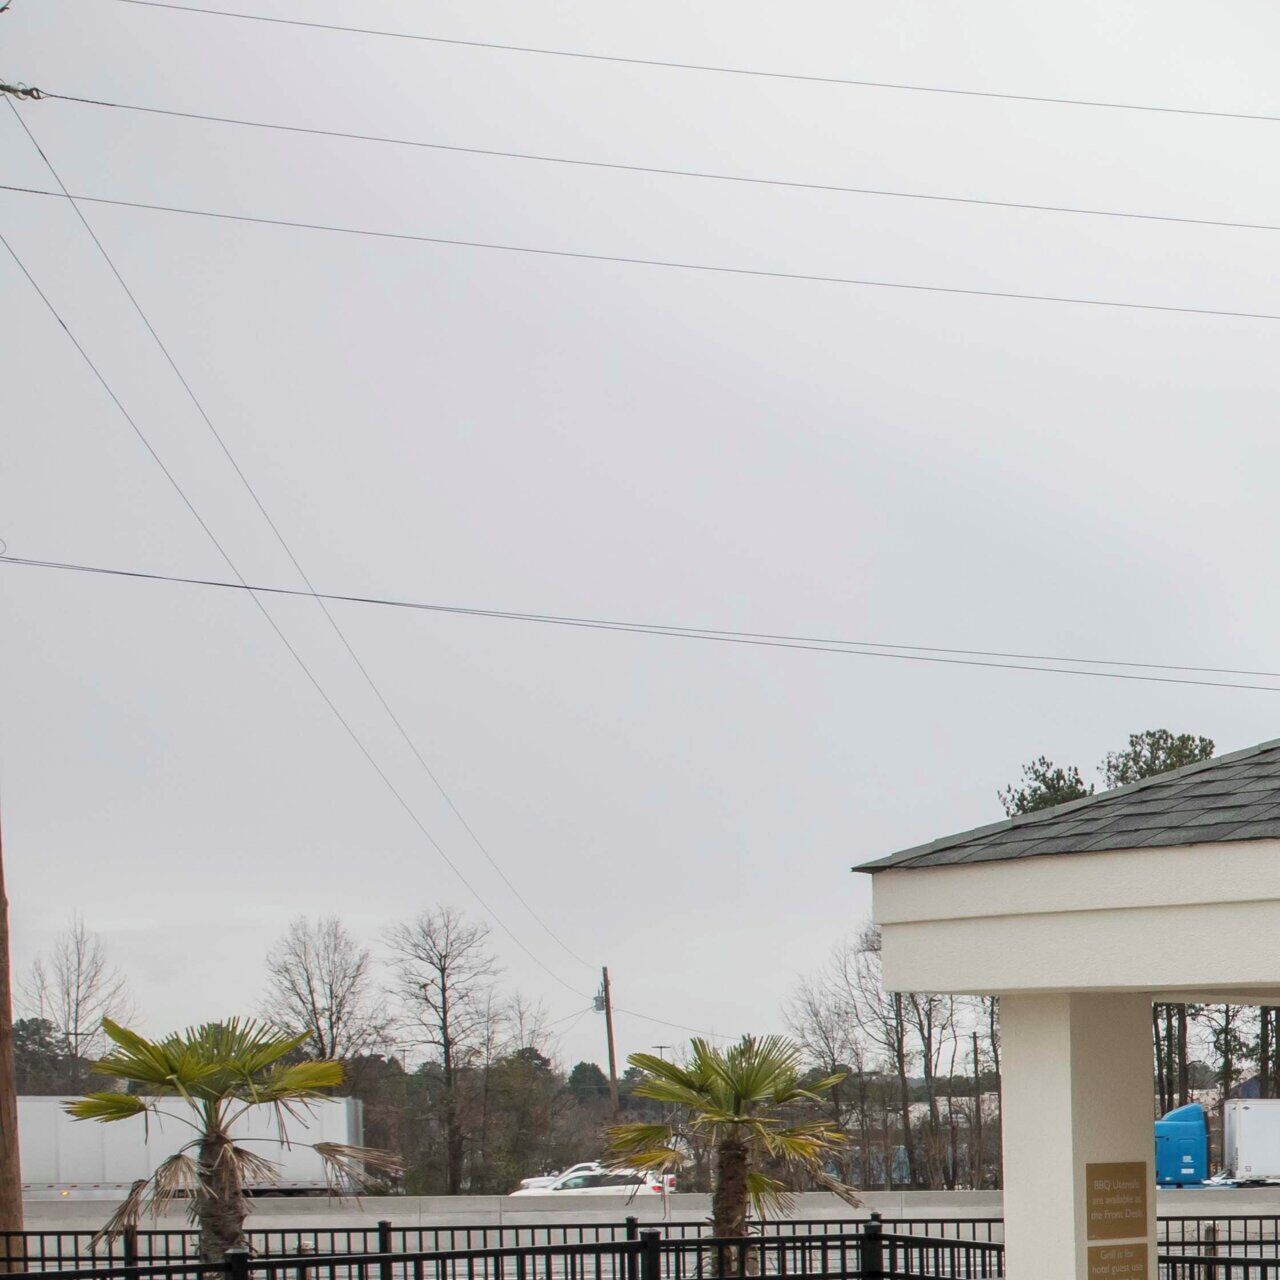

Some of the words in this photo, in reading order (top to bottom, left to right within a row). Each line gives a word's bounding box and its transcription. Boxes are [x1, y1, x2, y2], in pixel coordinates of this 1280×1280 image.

[1094, 1179, 1111, 1191] BBQ
[1091, 1210, 1104, 1220] the
[1104, 1209, 1123, 1219] Front
[1100, 1249, 1115, 1259] Grill
[1092, 1264, 1110, 1274] hotel
[1131, 1264, 1144, 1272] use
